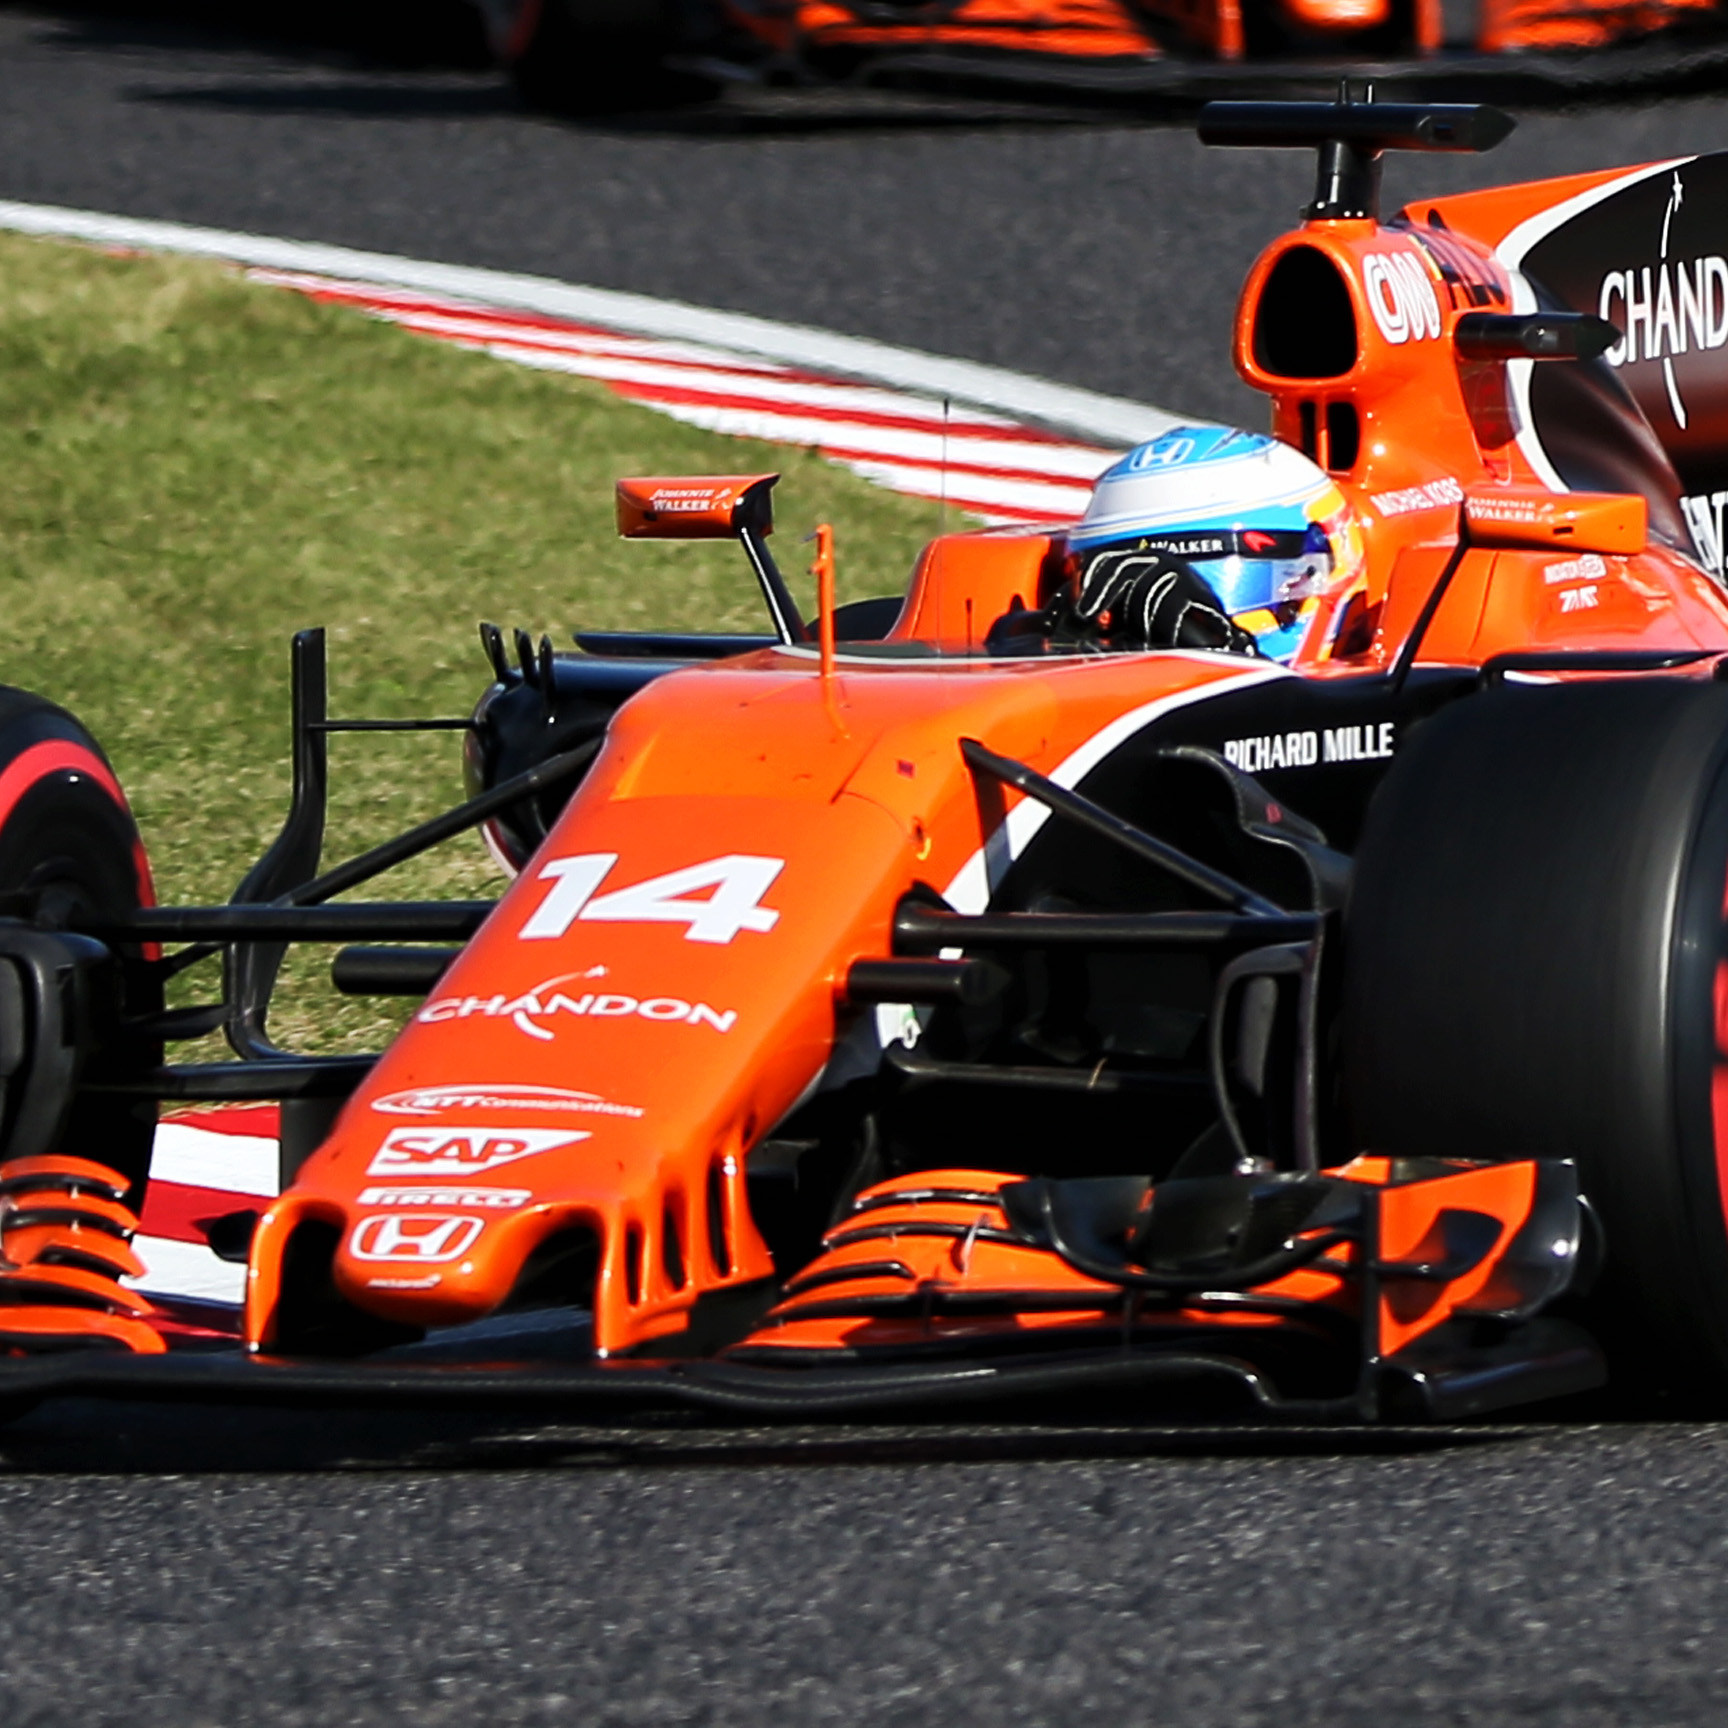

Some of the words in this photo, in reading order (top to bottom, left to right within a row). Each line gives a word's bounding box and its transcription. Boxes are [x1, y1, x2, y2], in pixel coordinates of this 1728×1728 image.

[1363, 251, 1441, 344] CNN
[649, 488, 715, 500] JOHNNIE
[653, 499, 711, 512] WALKER
[1469, 506, 1535, 521] WALKER
[1224, 731, 1318, 773] RICHARD
[1323, 722, 1394, 762] MILLE
[518, 853, 786, 944] 14
[418, 993, 738, 1032] CHANDON
[379, 1137, 529, 1164] SAP
[357, 1186, 532, 1208] PIRELLI
